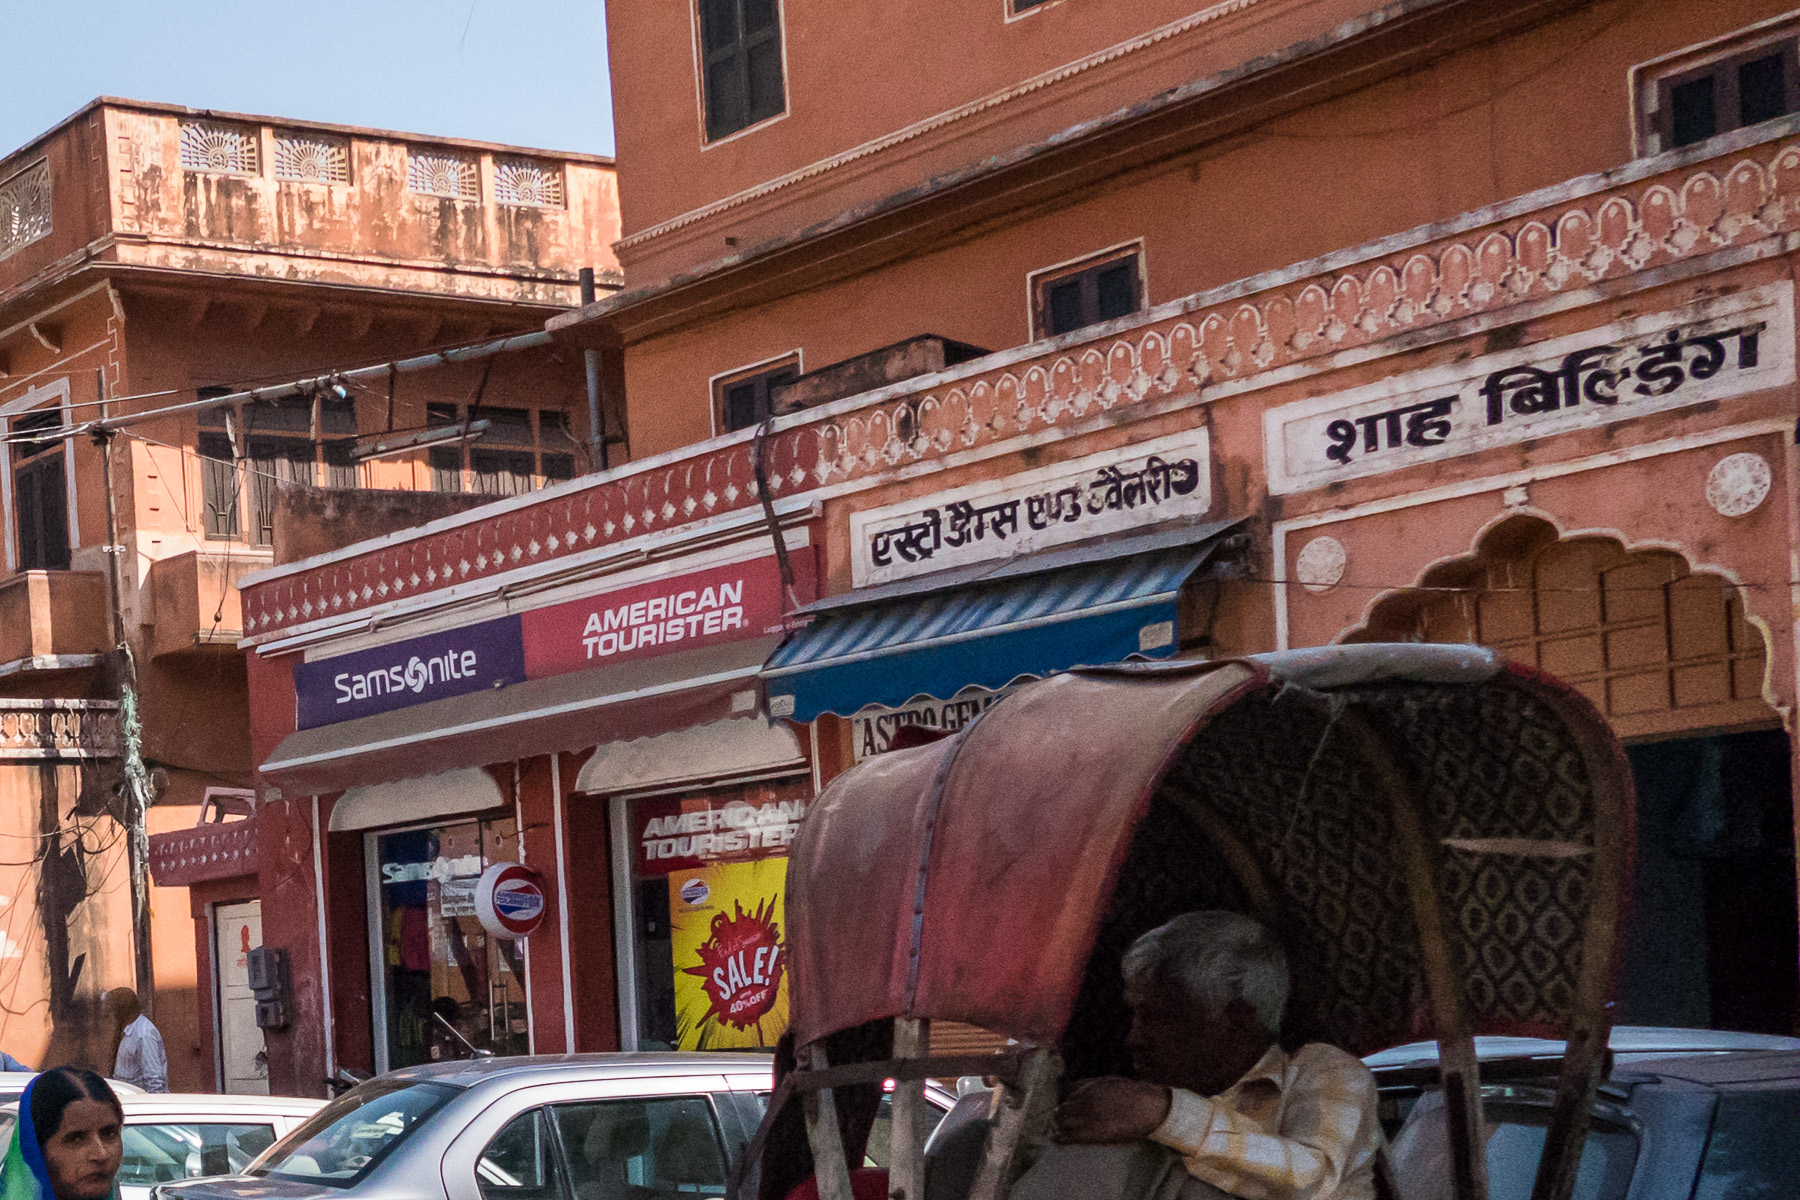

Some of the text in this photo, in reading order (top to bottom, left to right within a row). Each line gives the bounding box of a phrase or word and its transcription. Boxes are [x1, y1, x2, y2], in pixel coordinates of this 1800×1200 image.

[1325, 321, 1768, 464] शाह बिल्डिंग
[582, 579, 743, 636] AMERICAN
[582, 606, 743, 659] TOURISTER
[334, 649, 477, 704] Samsonite
[713, 945, 779, 1000] SALE!
